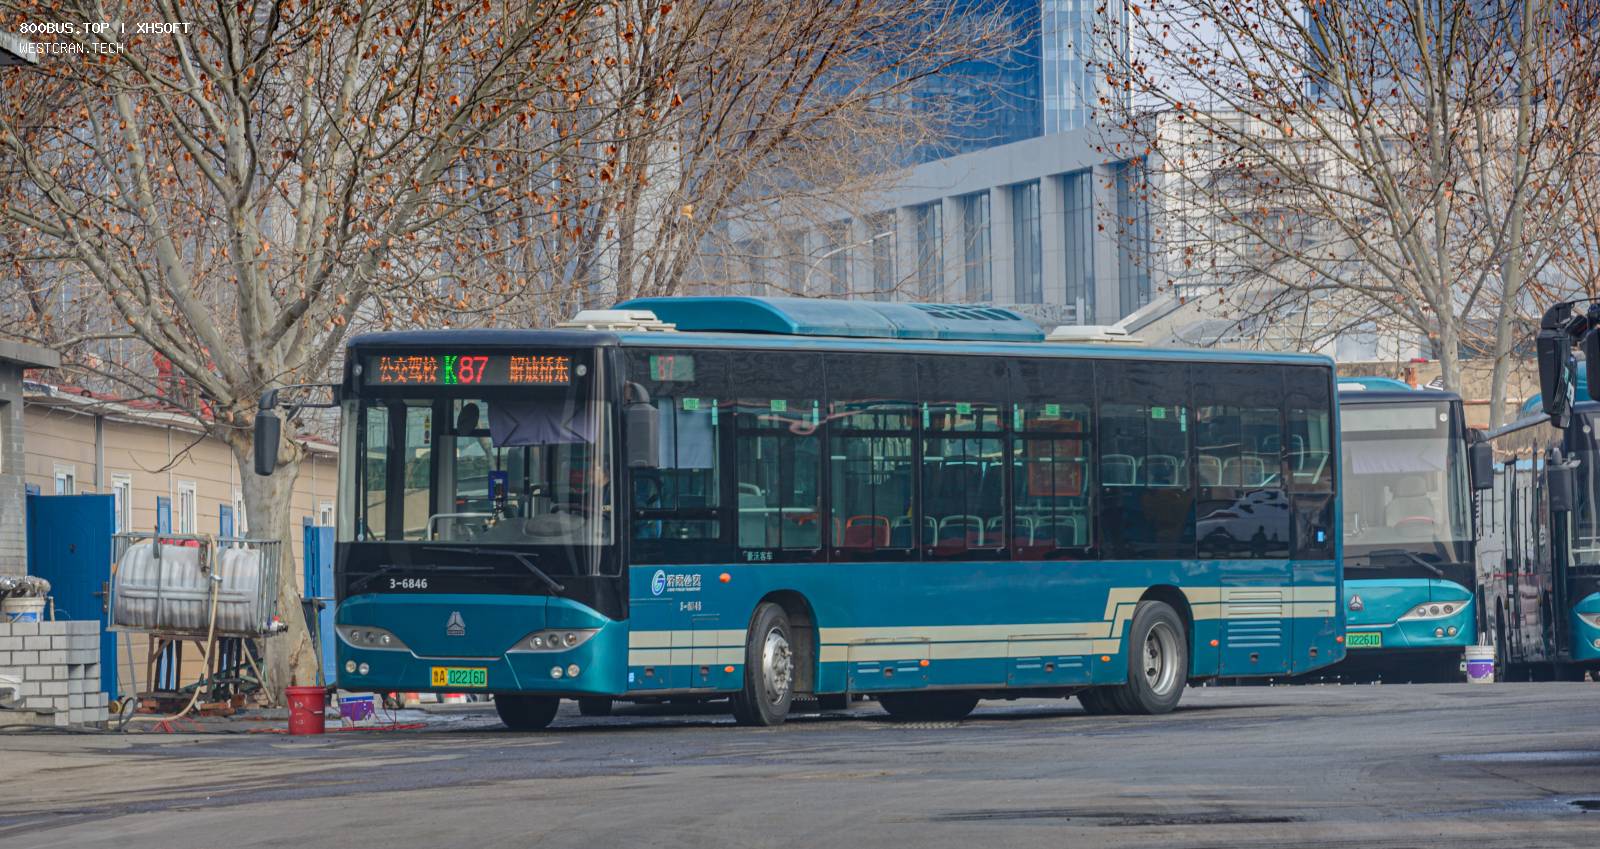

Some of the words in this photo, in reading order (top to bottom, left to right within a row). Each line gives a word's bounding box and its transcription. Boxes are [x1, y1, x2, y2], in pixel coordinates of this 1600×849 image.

[379, 355, 437, 384] 公交驾校
[444, 355, 489, 384] K87
[509, 355, 569, 384] 解放桥东
[389, 578, 428, 589] 3-6846
